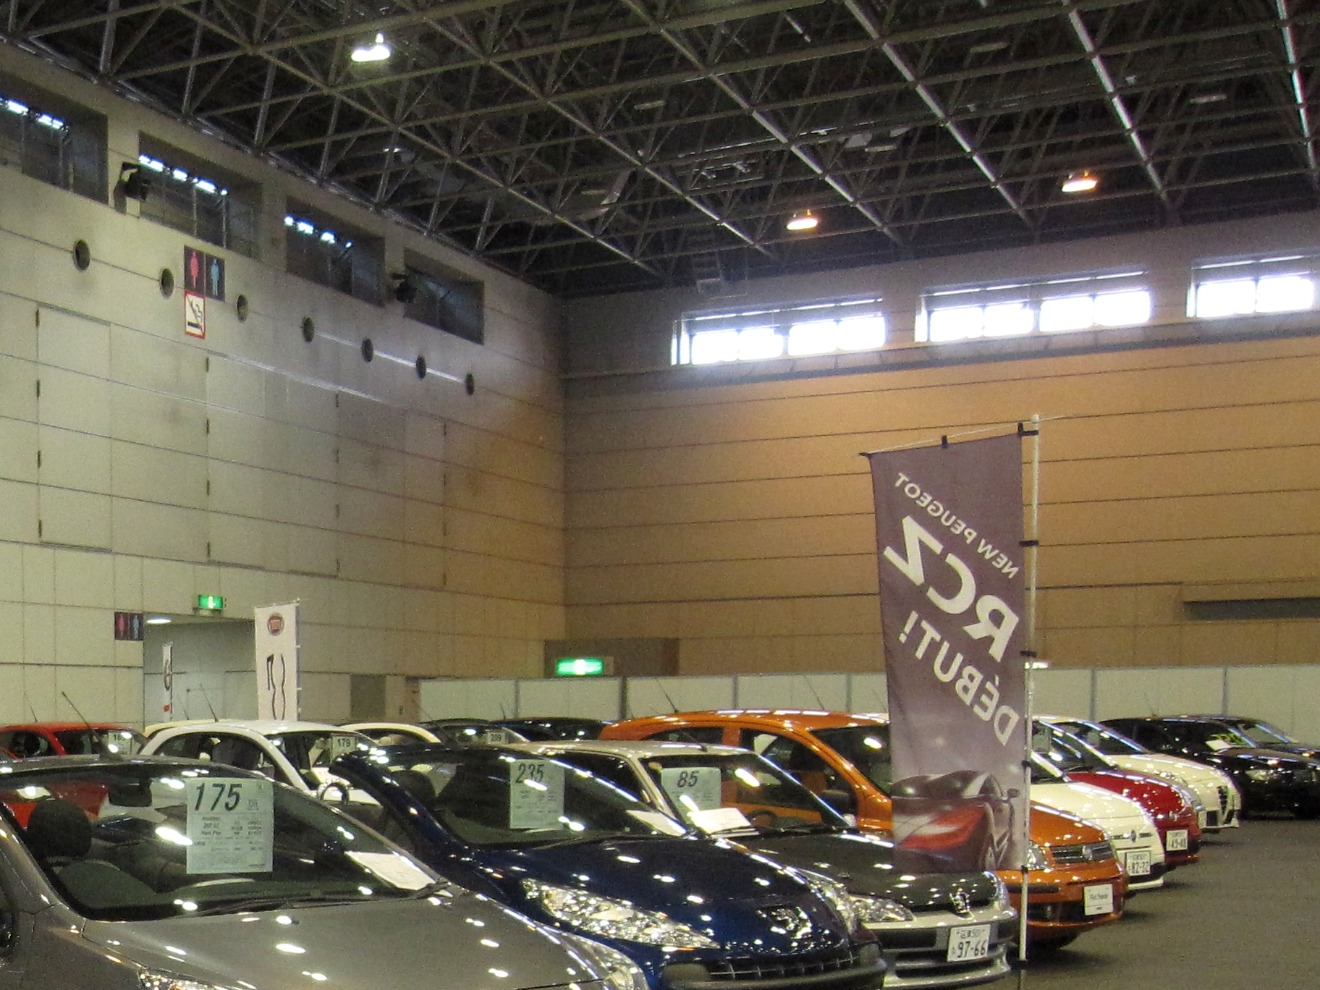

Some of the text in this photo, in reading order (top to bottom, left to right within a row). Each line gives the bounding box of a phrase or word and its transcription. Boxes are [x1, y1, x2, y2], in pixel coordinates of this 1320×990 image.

[337, 737, 351, 747] 179
[677, 770, 700, 788] 85
[194, 783, 242, 811] 175
[957, 939, 988, 958] 97-66
